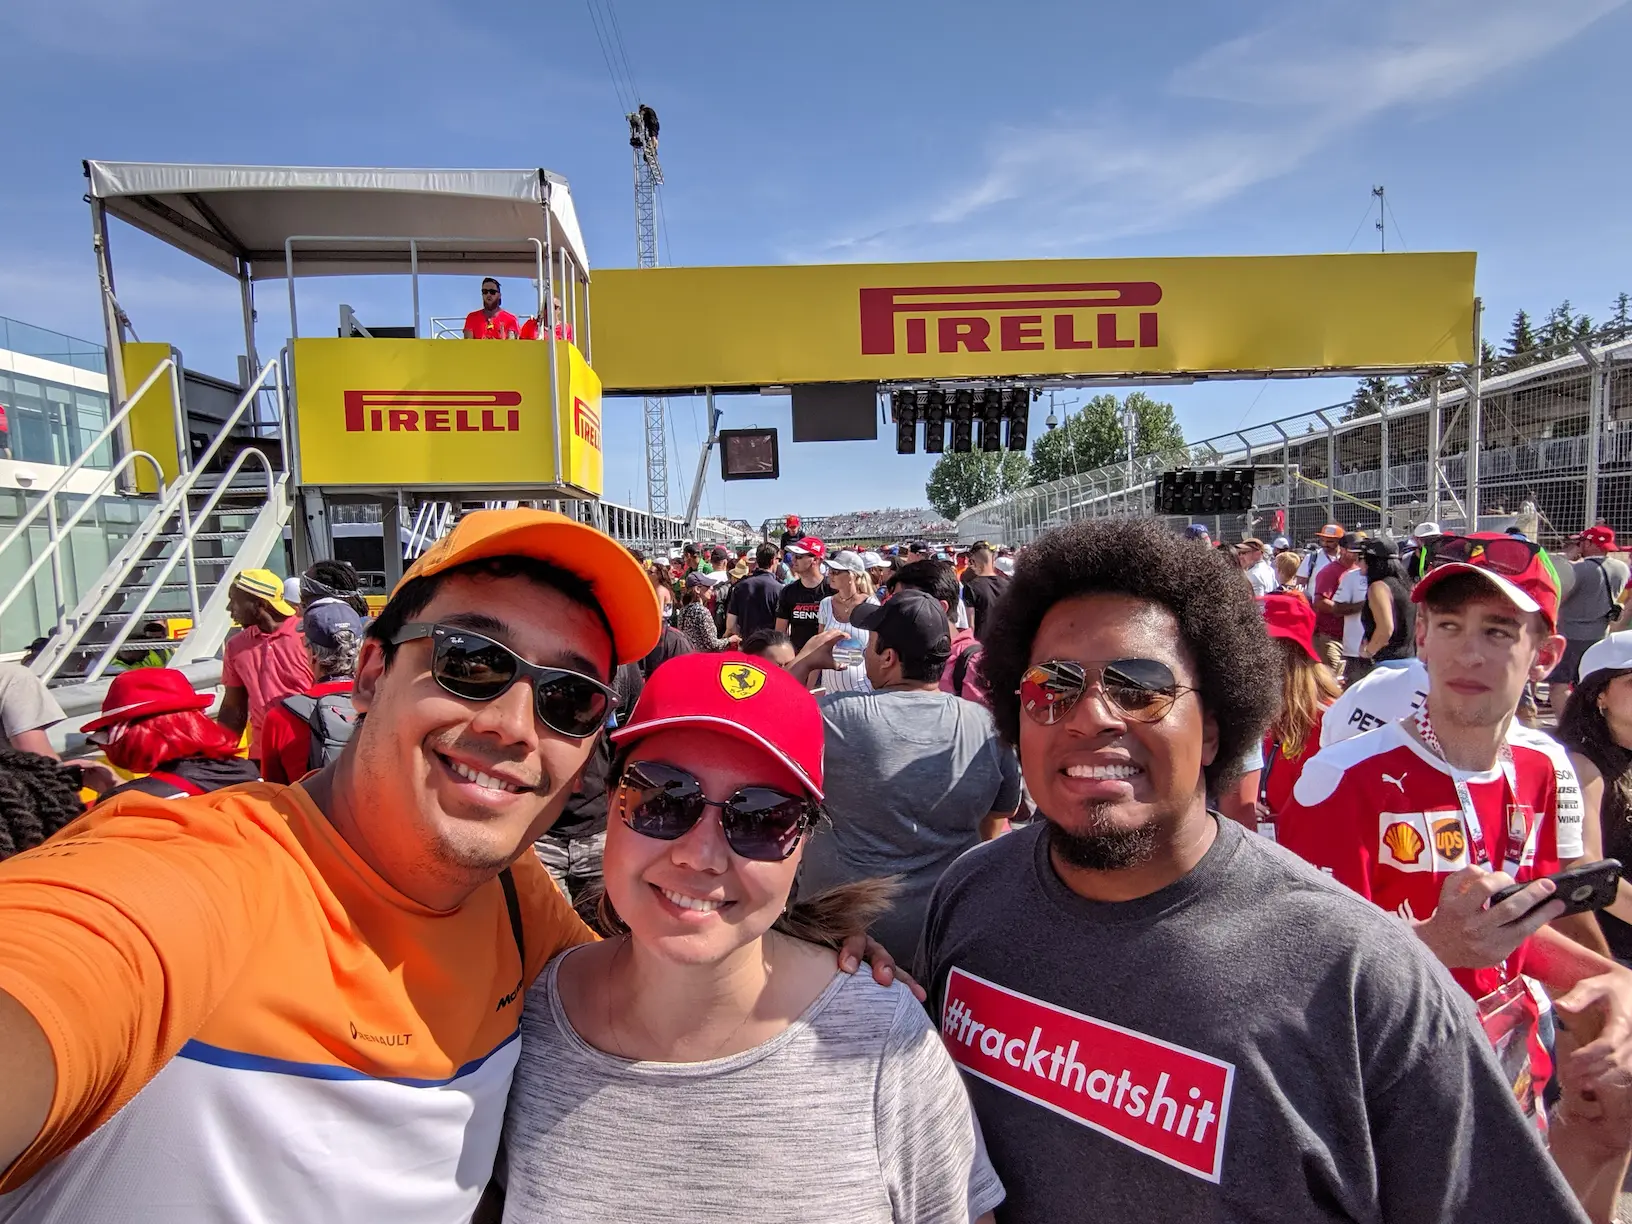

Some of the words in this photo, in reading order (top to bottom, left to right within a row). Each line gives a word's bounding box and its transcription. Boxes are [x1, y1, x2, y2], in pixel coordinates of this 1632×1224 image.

[860, 282, 1163, 355] PIRELLI
[344, 390, 522, 431] PIRELLI
[1436, 830, 1465, 856] ups
[357, 1032, 413, 1046] RENAULT
[945, 998, 1216, 1143] #trackthatshit
